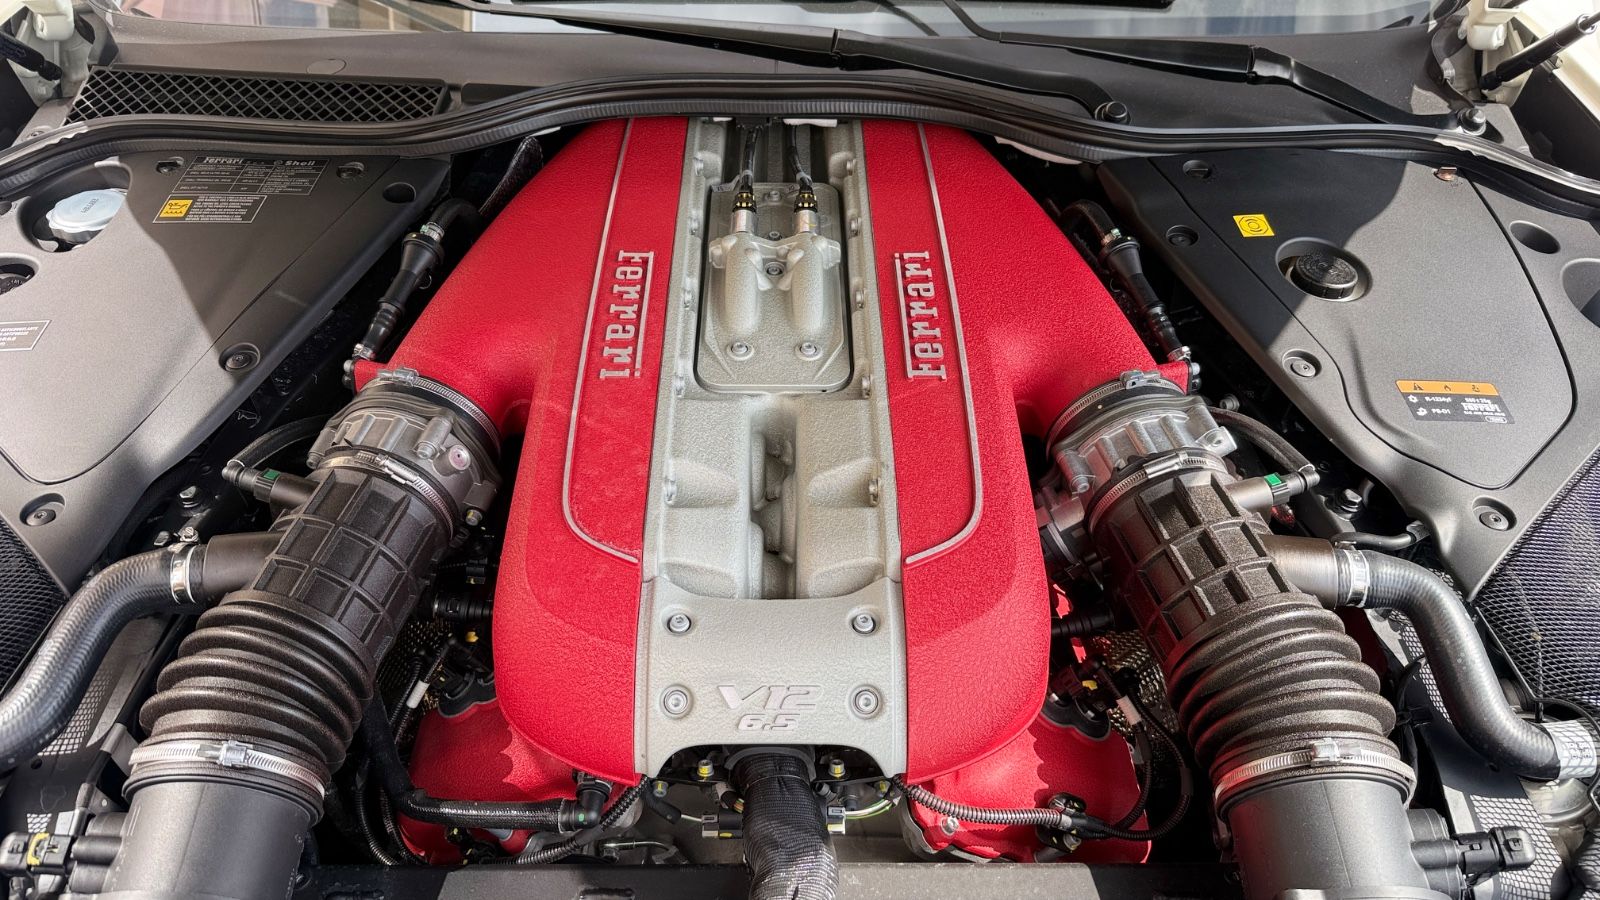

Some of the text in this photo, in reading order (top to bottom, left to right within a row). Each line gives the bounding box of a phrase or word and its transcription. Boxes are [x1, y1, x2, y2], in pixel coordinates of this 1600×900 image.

[203, 156, 243, 164] Ferrari
[600, 250, 654, 379] Ferrari
[894, 250, 947, 380] Ferrari
[718, 685, 824, 711] V12
[738, 713, 800, 732] 6.5
